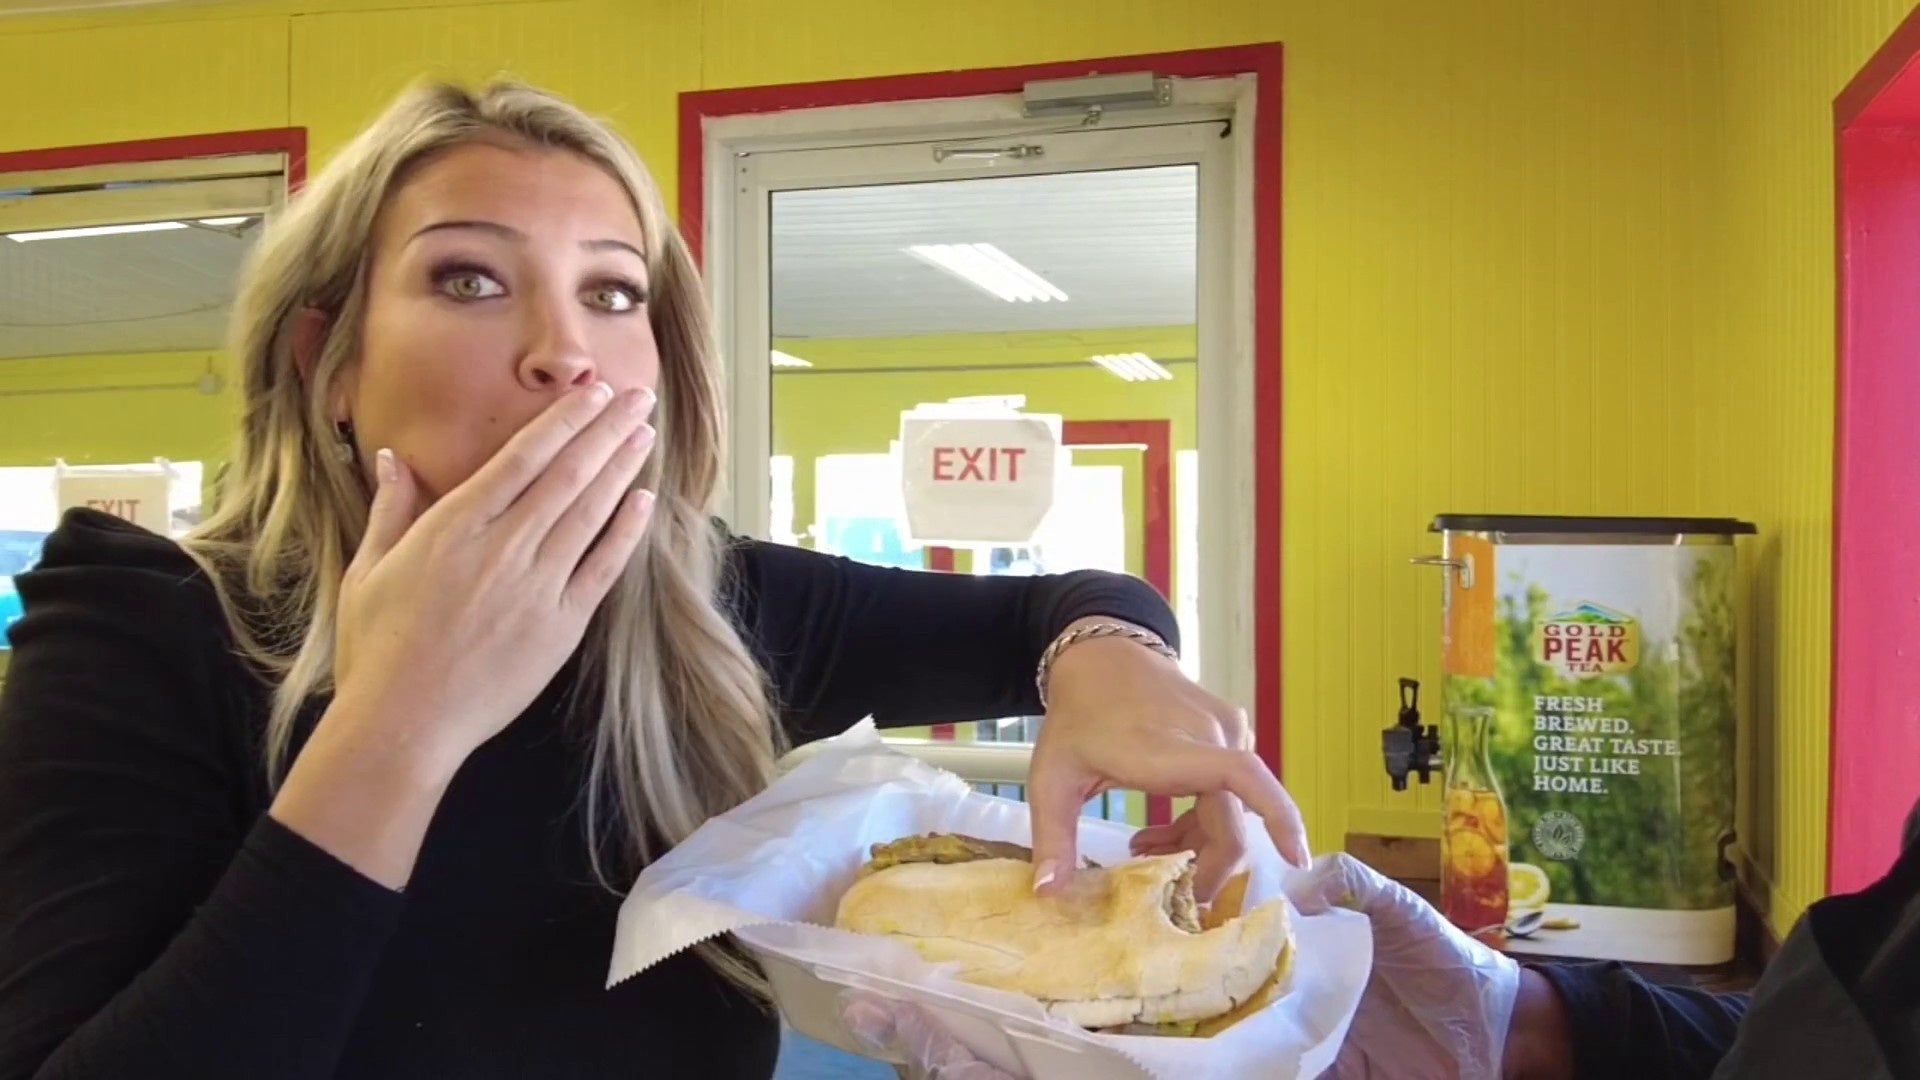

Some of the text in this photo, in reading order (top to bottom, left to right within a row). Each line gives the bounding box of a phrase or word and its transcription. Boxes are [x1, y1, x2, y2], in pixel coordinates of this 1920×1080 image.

[932, 446, 1027, 482] EXIT
[1543, 623, 1627, 637] GOLD
[1543, 637, 1629, 662] PEAK
[1566, 662, 1604, 673] TEA
[1533, 695, 1604, 713] FRESH
[1533, 714, 1635, 734] BREWED.
[1533, 735, 1682, 756] GREAT TASTE.
[1533, 755, 1641, 775] JUST LIKE
[1532, 774, 1609, 794] HOME.
